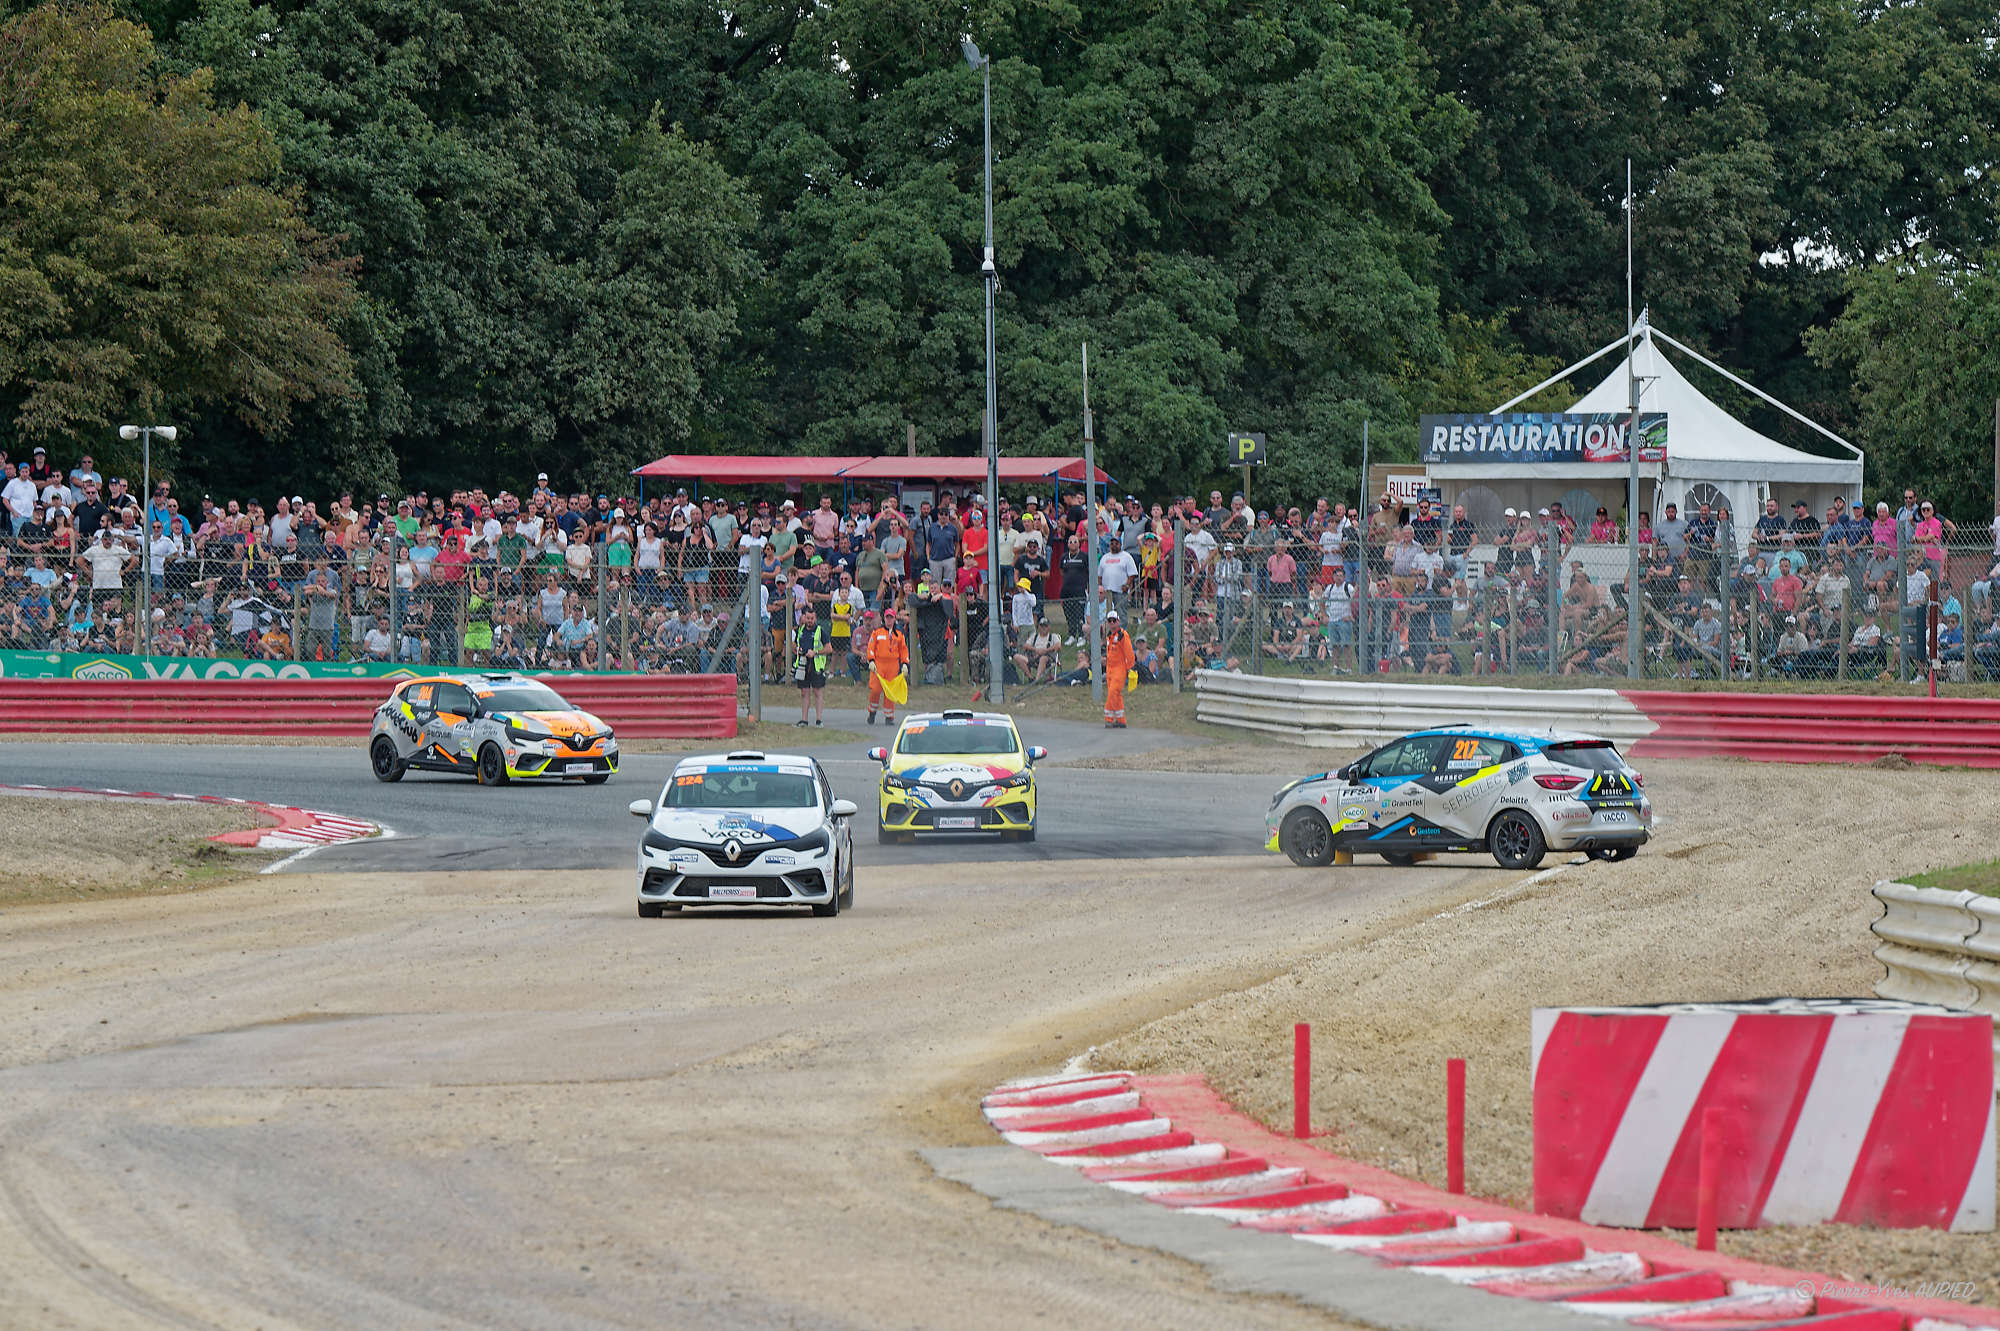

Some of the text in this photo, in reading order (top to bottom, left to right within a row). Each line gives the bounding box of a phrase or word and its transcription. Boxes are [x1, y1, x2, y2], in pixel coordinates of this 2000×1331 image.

[1432, 424, 1625, 452] RESTAURATION
[1239, 438, 1255, 460] P
[82, 671, 124, 680] YACCO
[1453, 740, 1479, 760] 217
[676, 775, 703, 786] 224
[1342, 787, 1373, 797] FFSA
[1391, 799, 1423, 808] GrandTek
[1500, 796, 1529, 804] Deloitte
[1344, 808, 1365, 817] YACCO
[1602, 812, 1627, 822] YACCO
[706, 829, 764, 839] YACCO
